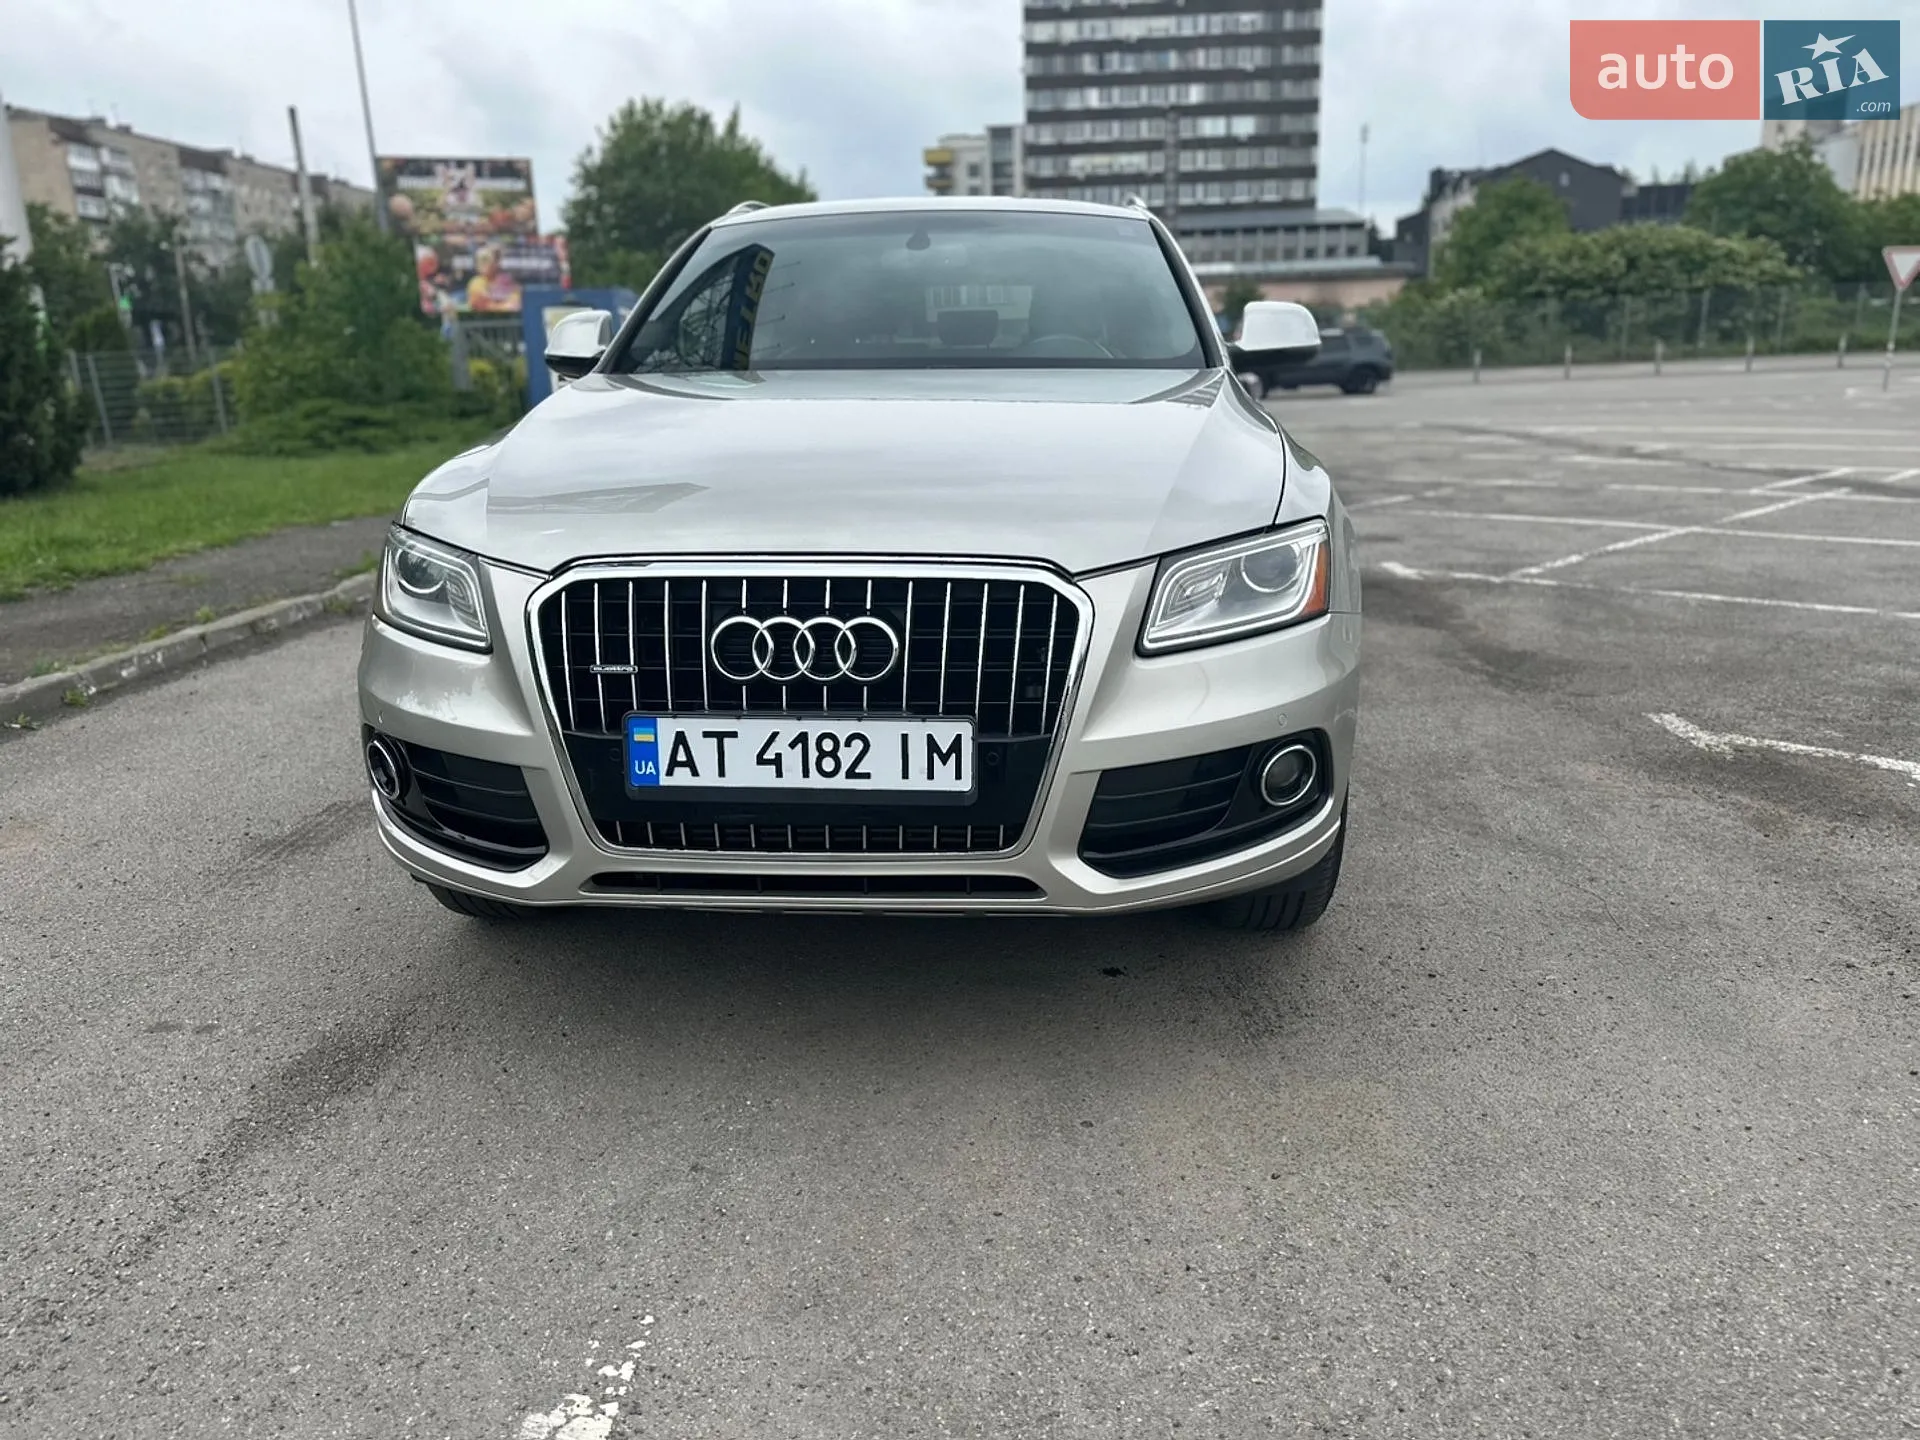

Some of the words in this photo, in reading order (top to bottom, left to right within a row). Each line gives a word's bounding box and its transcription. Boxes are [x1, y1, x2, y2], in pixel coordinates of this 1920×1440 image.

[634, 759, 657, 776] UA
[664, 730, 739, 779] AT
[755, 731, 872, 780] 4182
[900, 733, 963, 781] IM
